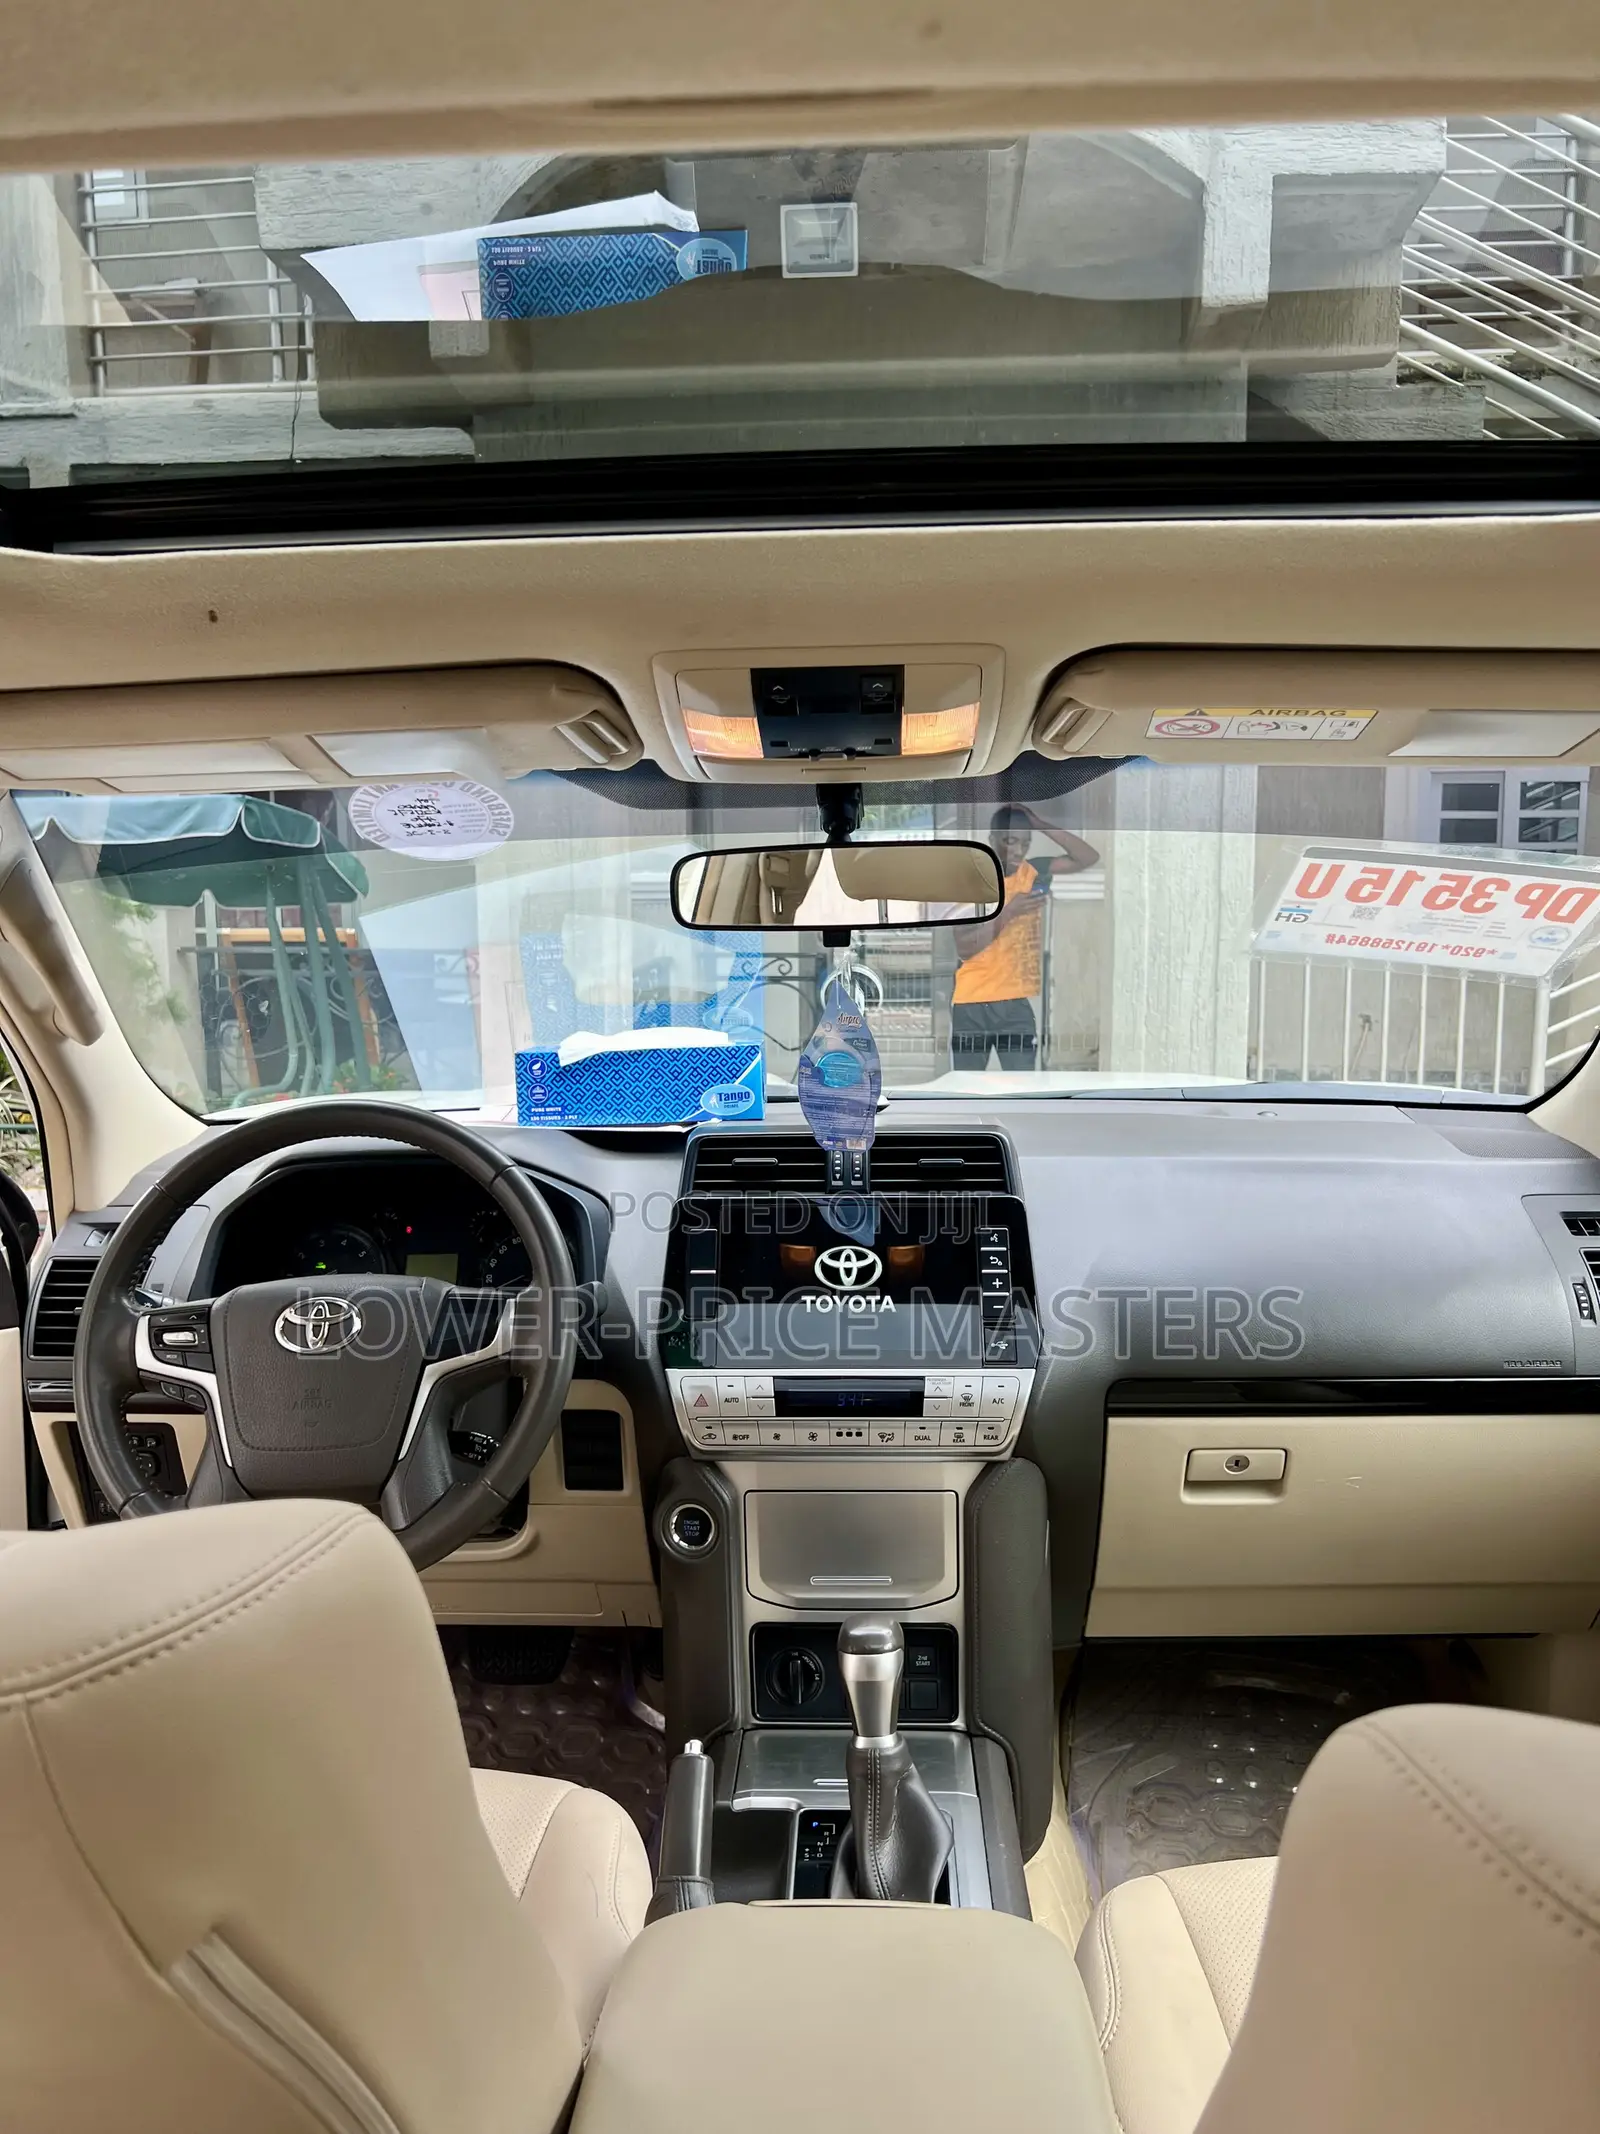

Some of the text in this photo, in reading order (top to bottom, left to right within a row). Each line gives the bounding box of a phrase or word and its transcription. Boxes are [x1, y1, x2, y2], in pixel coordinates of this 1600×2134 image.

[1249, 708, 1348, 717] AIRBAG
[716, 1091, 751, 1102] Tango
[801, 1294, 897, 1314] TOYOTA
